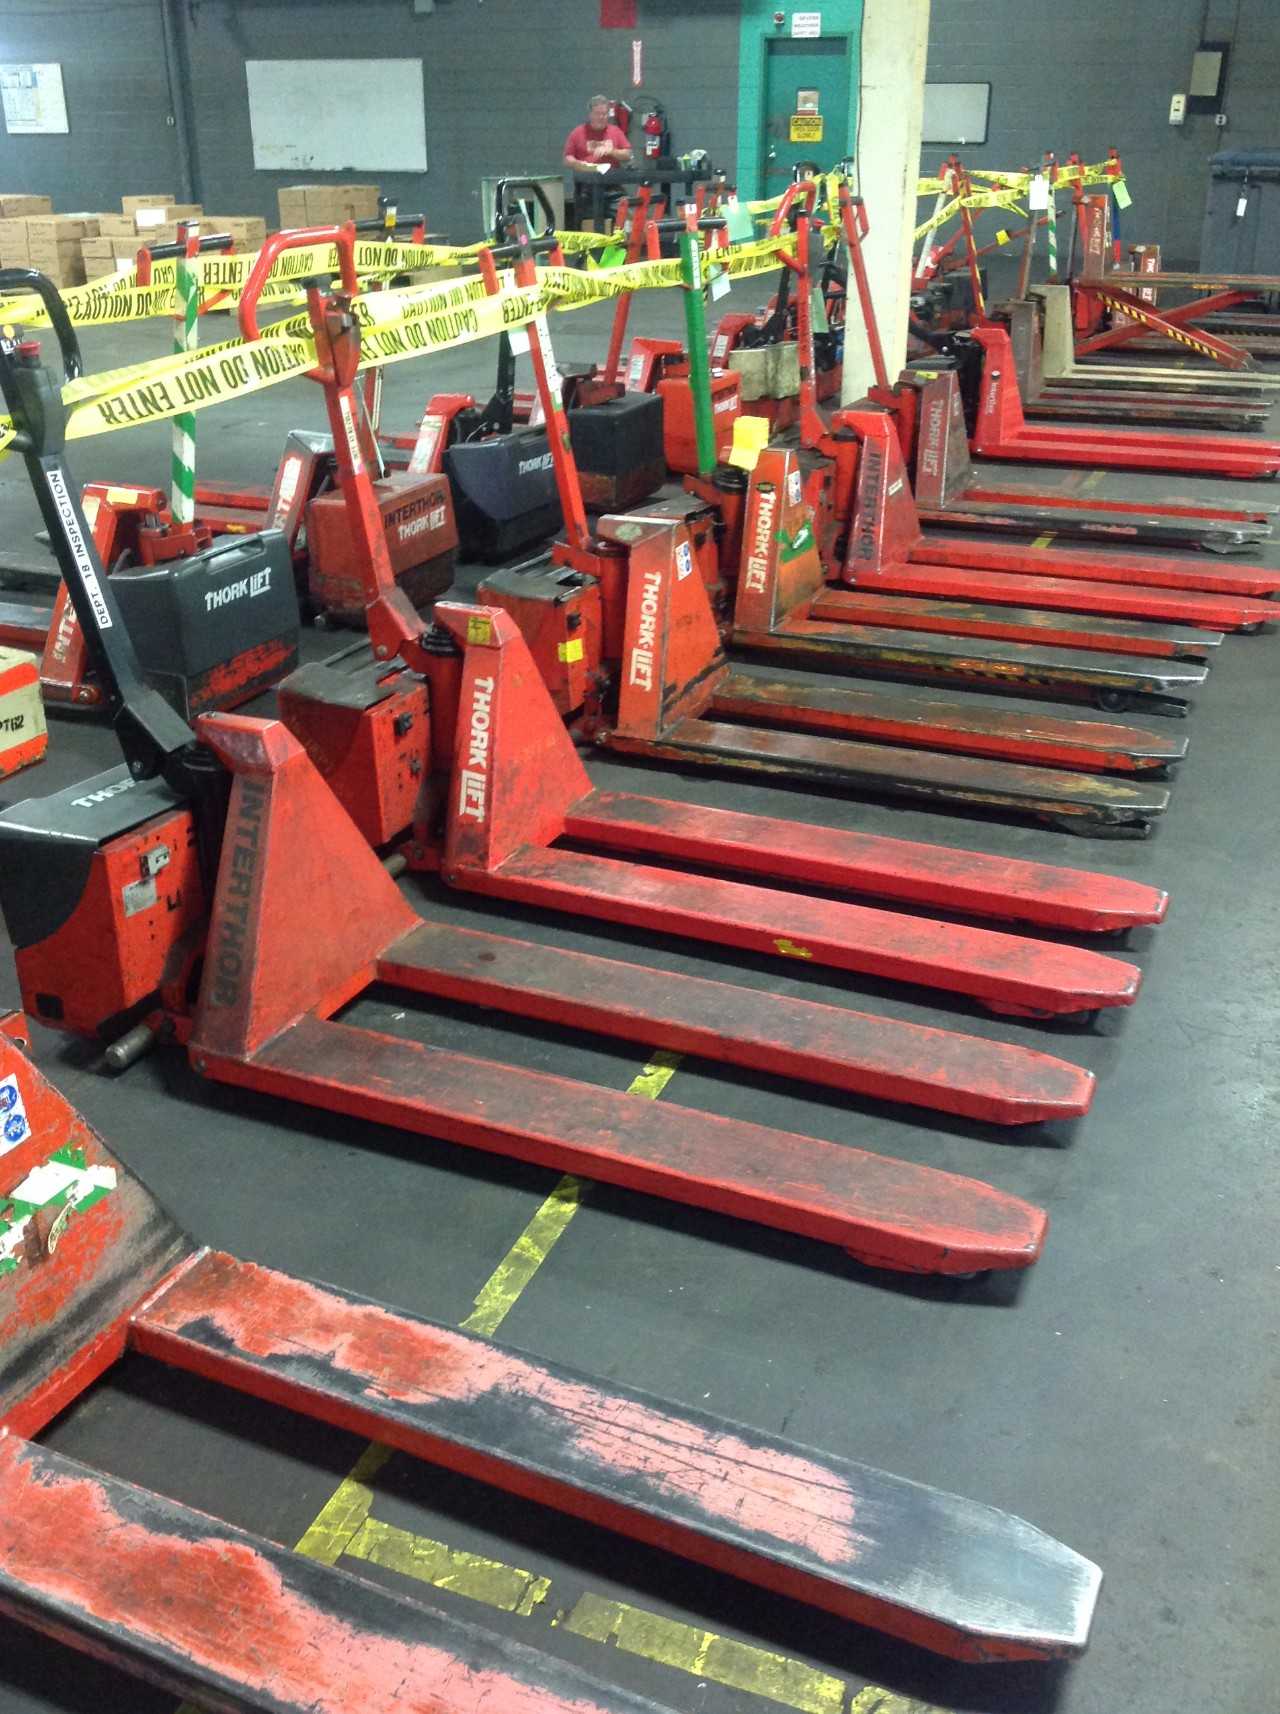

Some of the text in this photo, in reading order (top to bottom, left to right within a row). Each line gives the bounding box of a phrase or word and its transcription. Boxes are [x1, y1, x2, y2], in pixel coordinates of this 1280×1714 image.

[203, 261, 243, 285] ENTER
[72, 293, 133, 321] CAUTION
[375, 331, 408, 357] NOT
[404, 322, 428, 350] DO
[425, 308, 478, 345] CAUTION
[174, 364, 221, 405] NOT
[219, 355, 250, 390] DO
[96, 381, 176, 426] ENTER
[397, 514, 430, 541] THORK
[754, 491, 777, 557] THORK
[49, 472, 108, 625] DEPT. 18 INSPECTION
[204, 577, 249, 612] THORK
[638, 571, 662, 646] THORK
[468, 676, 494, 770] THORK
[70, 777, 137, 808] THOR
[212, 781, 266, 1009] INTERTHOR
